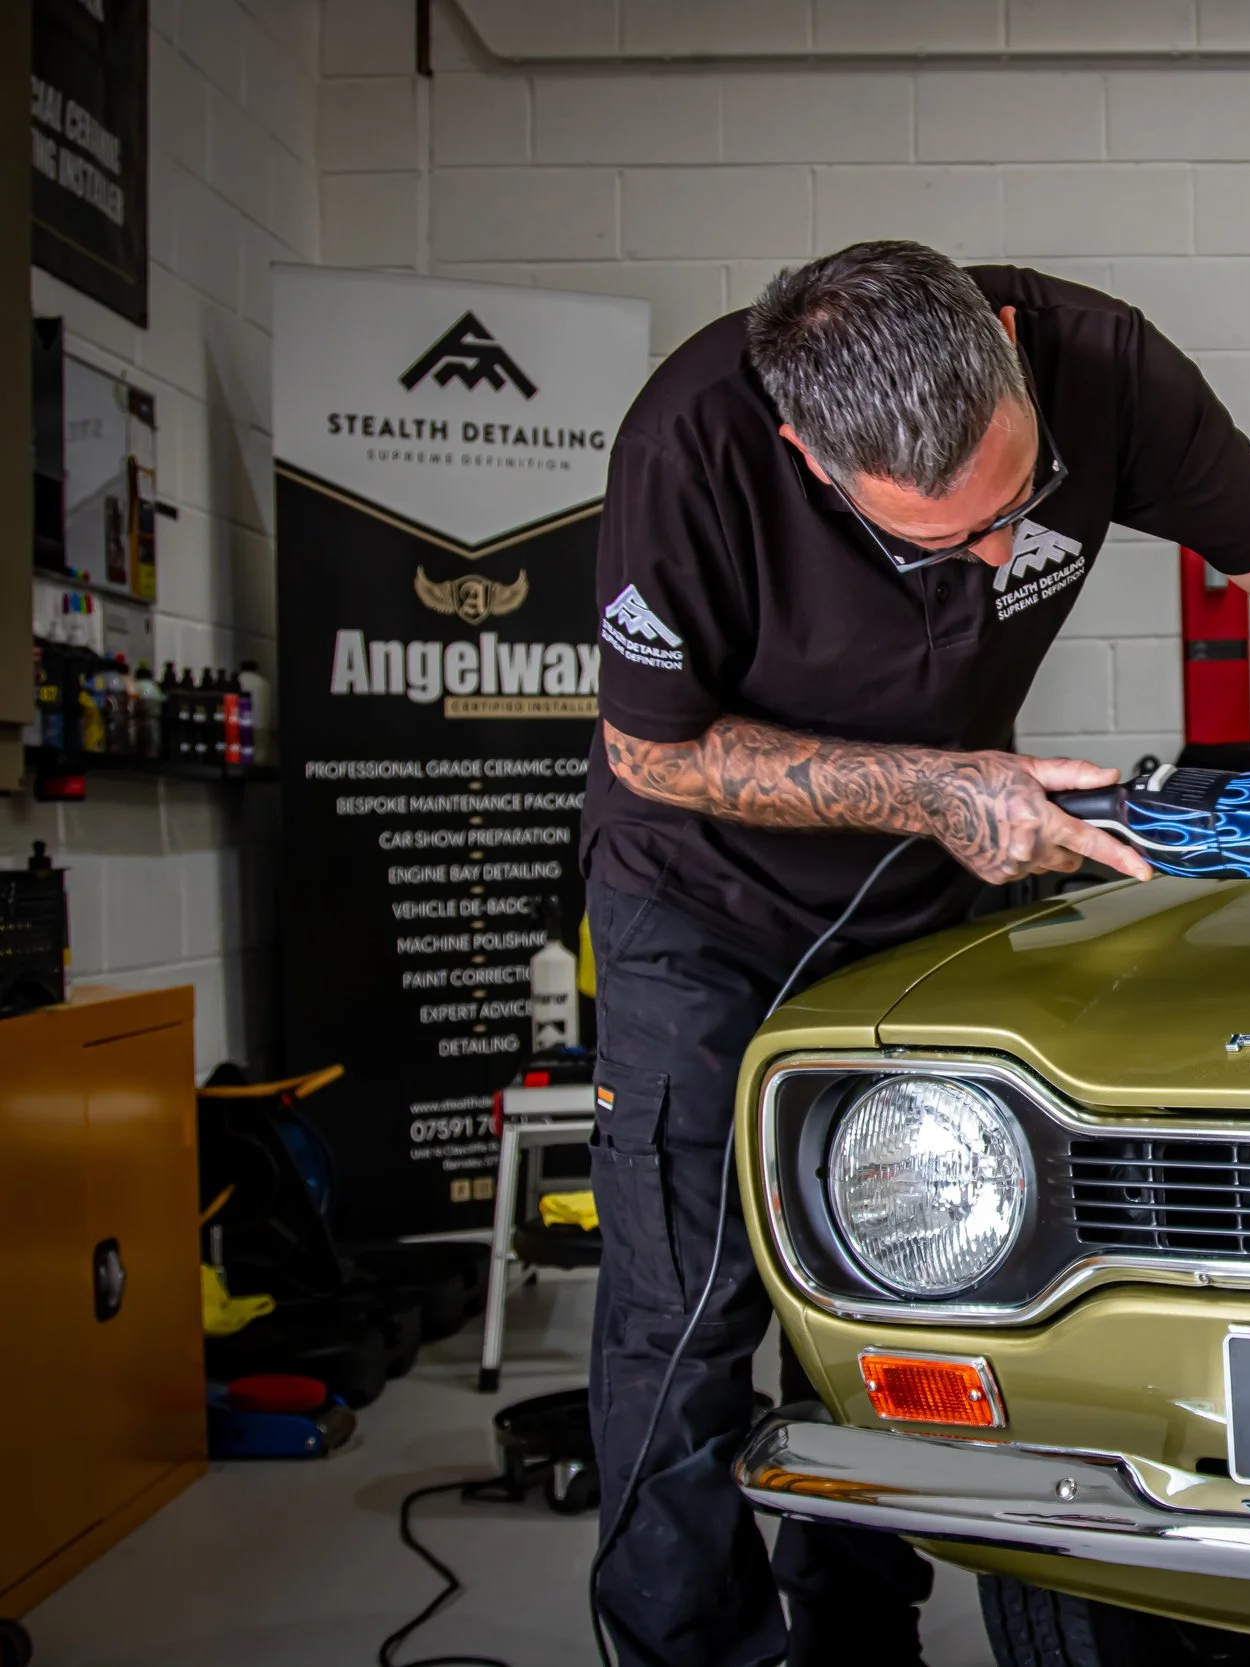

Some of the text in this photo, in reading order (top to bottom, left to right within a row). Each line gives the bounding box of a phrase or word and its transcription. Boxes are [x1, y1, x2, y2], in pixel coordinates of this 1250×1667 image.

[326, 412, 606, 450] STEALTH DETAILING
[367, 448, 572, 471] SUPREME DEFINITION
[995, 556, 1085, 609] STEALTH DETAILING
[998, 594, 1040, 620] SUPREME
[625, 651, 683, 670] DEFINITION
[626, 640, 683, 660] DETAILING
[330, 629, 600, 704] Angelwax
[527, 701, 600, 713] INSTALLE
[305, 760, 425, 780] PROFESSIONAL
[425, 758, 481, 778] GRADE
[483, 758, 554, 778] CERAMIC
[336, 794, 409, 815] BESPOKE
[409, 792, 522, 813] MAINTENANCE
[378, 827, 571, 850] CAR SHOW PREPARATION
[388, 861, 563, 885] ENGINE BAY DETAILING
[391, 899, 458, 919] VEHICLE
[396, 932, 472, 954] MACHINE
[402, 968, 447, 989] PAINT
[420, 999, 534, 1024] EXPERT ADVICE
[438, 1033, 520, 1057] DETAILING
[410, 1115, 474, 1142] 07591
